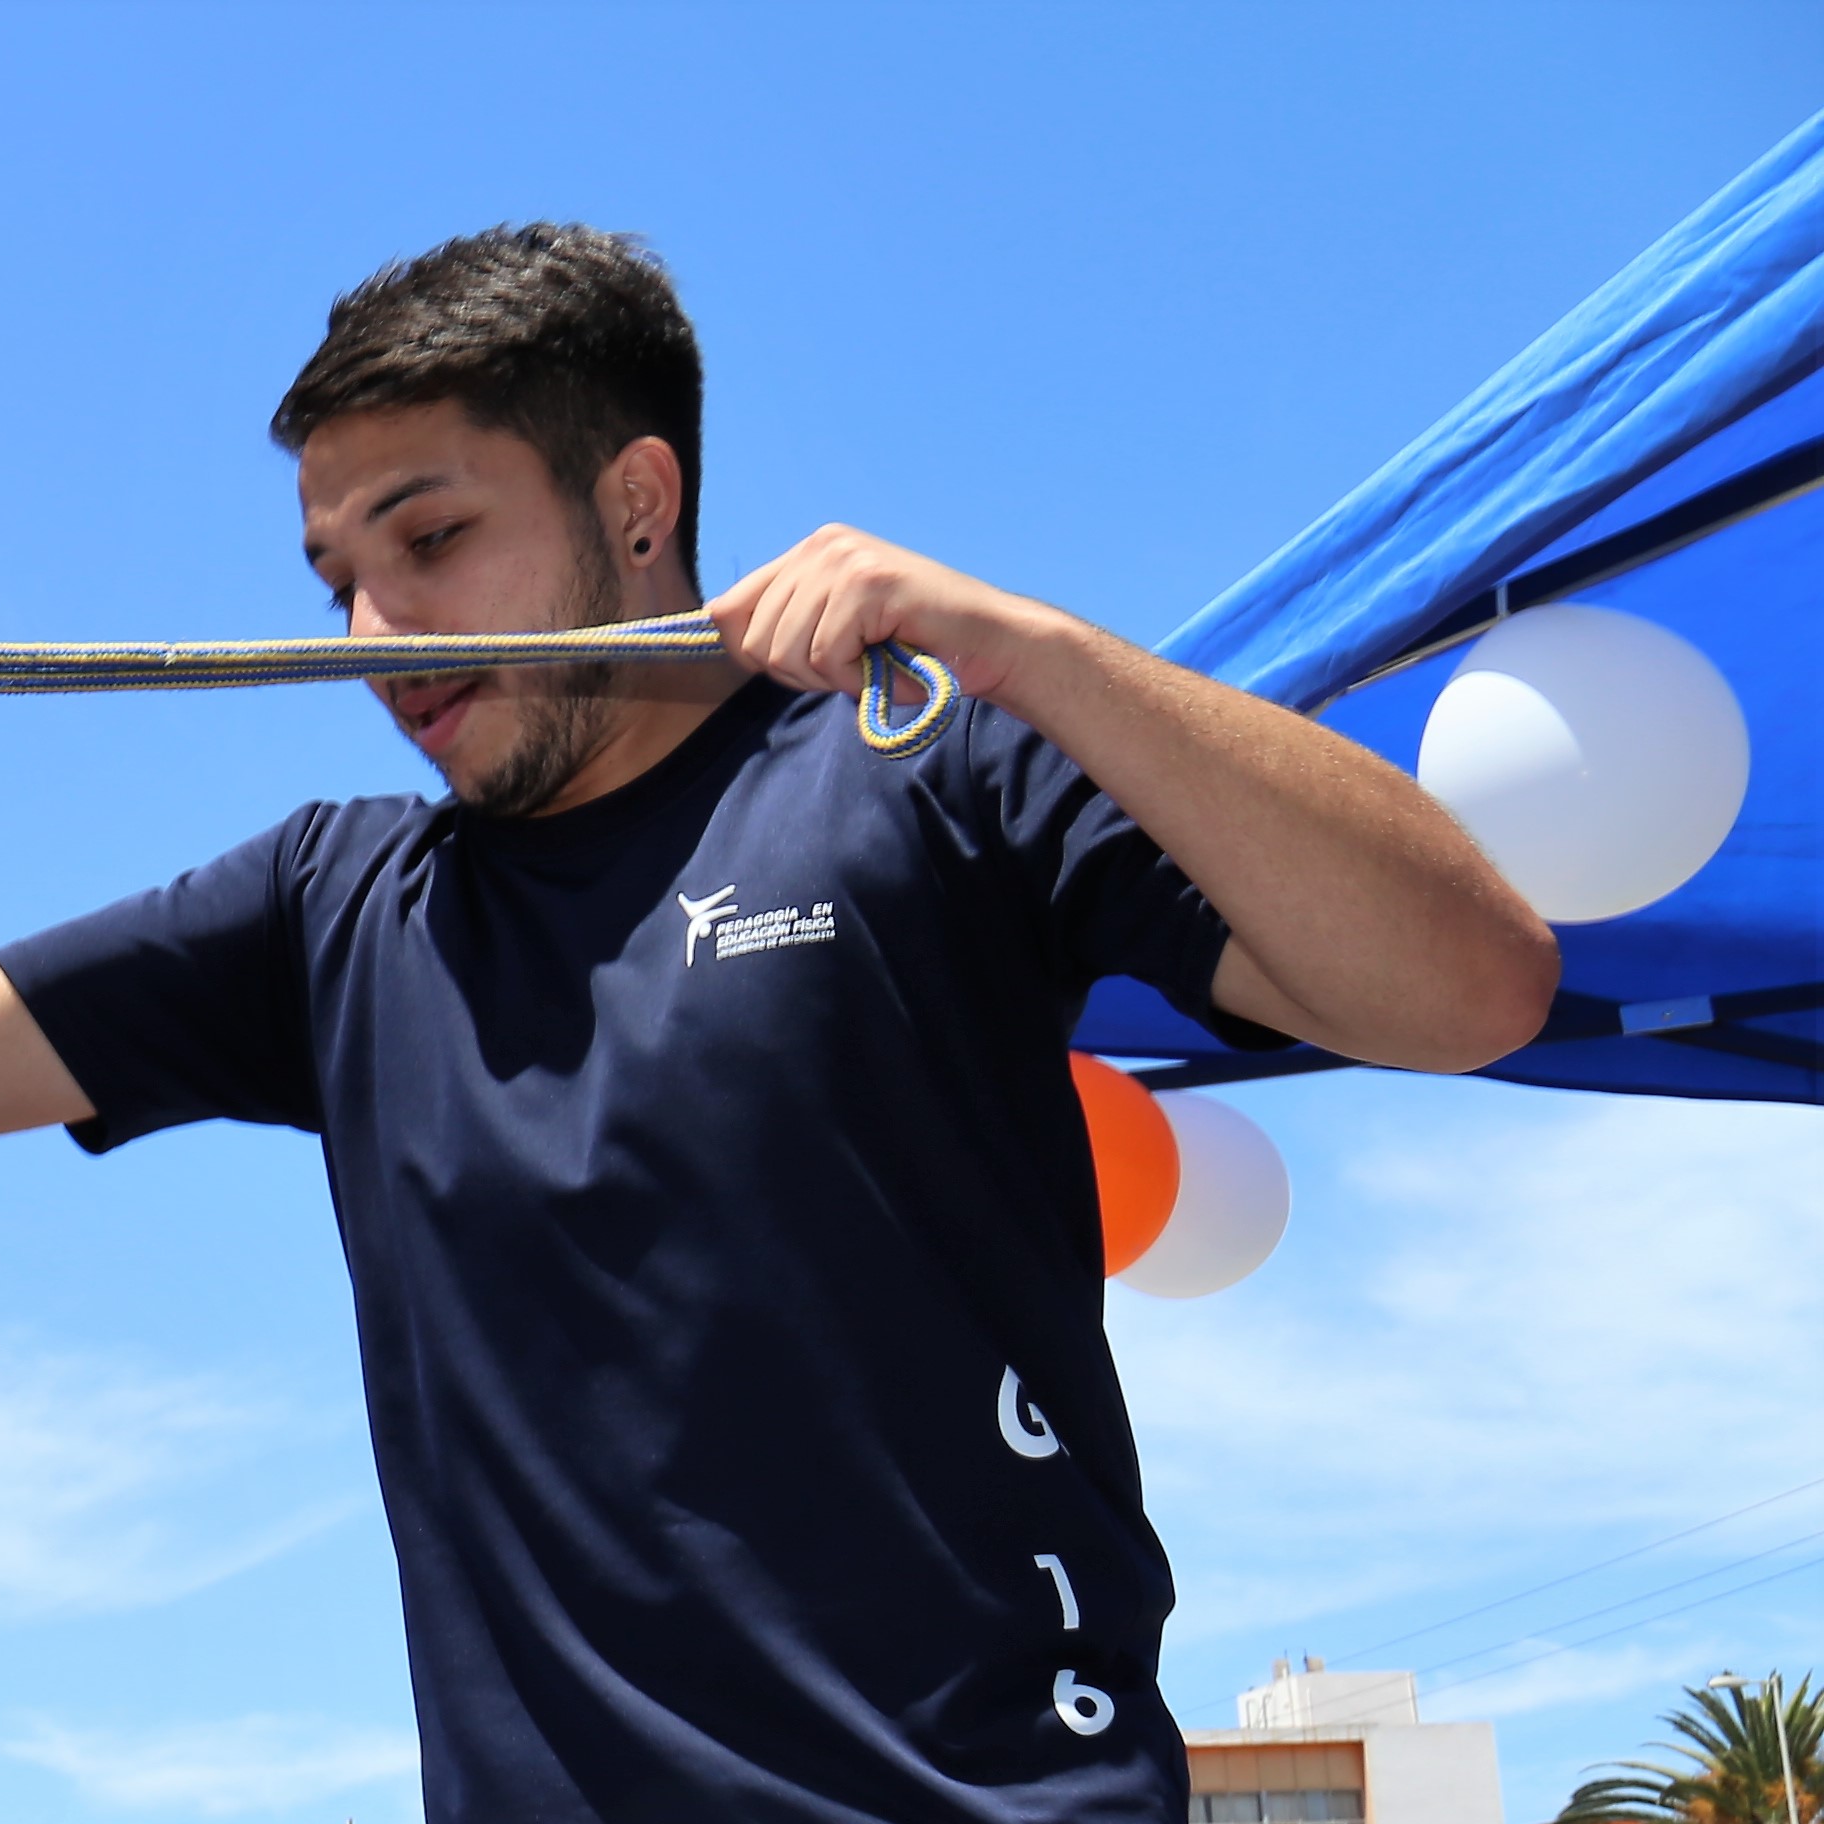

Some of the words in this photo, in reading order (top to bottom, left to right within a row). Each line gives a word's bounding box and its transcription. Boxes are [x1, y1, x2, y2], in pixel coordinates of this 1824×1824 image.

[716, 906, 799, 938] PEDAGOGÍA
[812, 902, 833, 918] EN
[716, 922, 791, 950] EDUCACIÓN
[793, 916, 835, 934] FÍSICA
